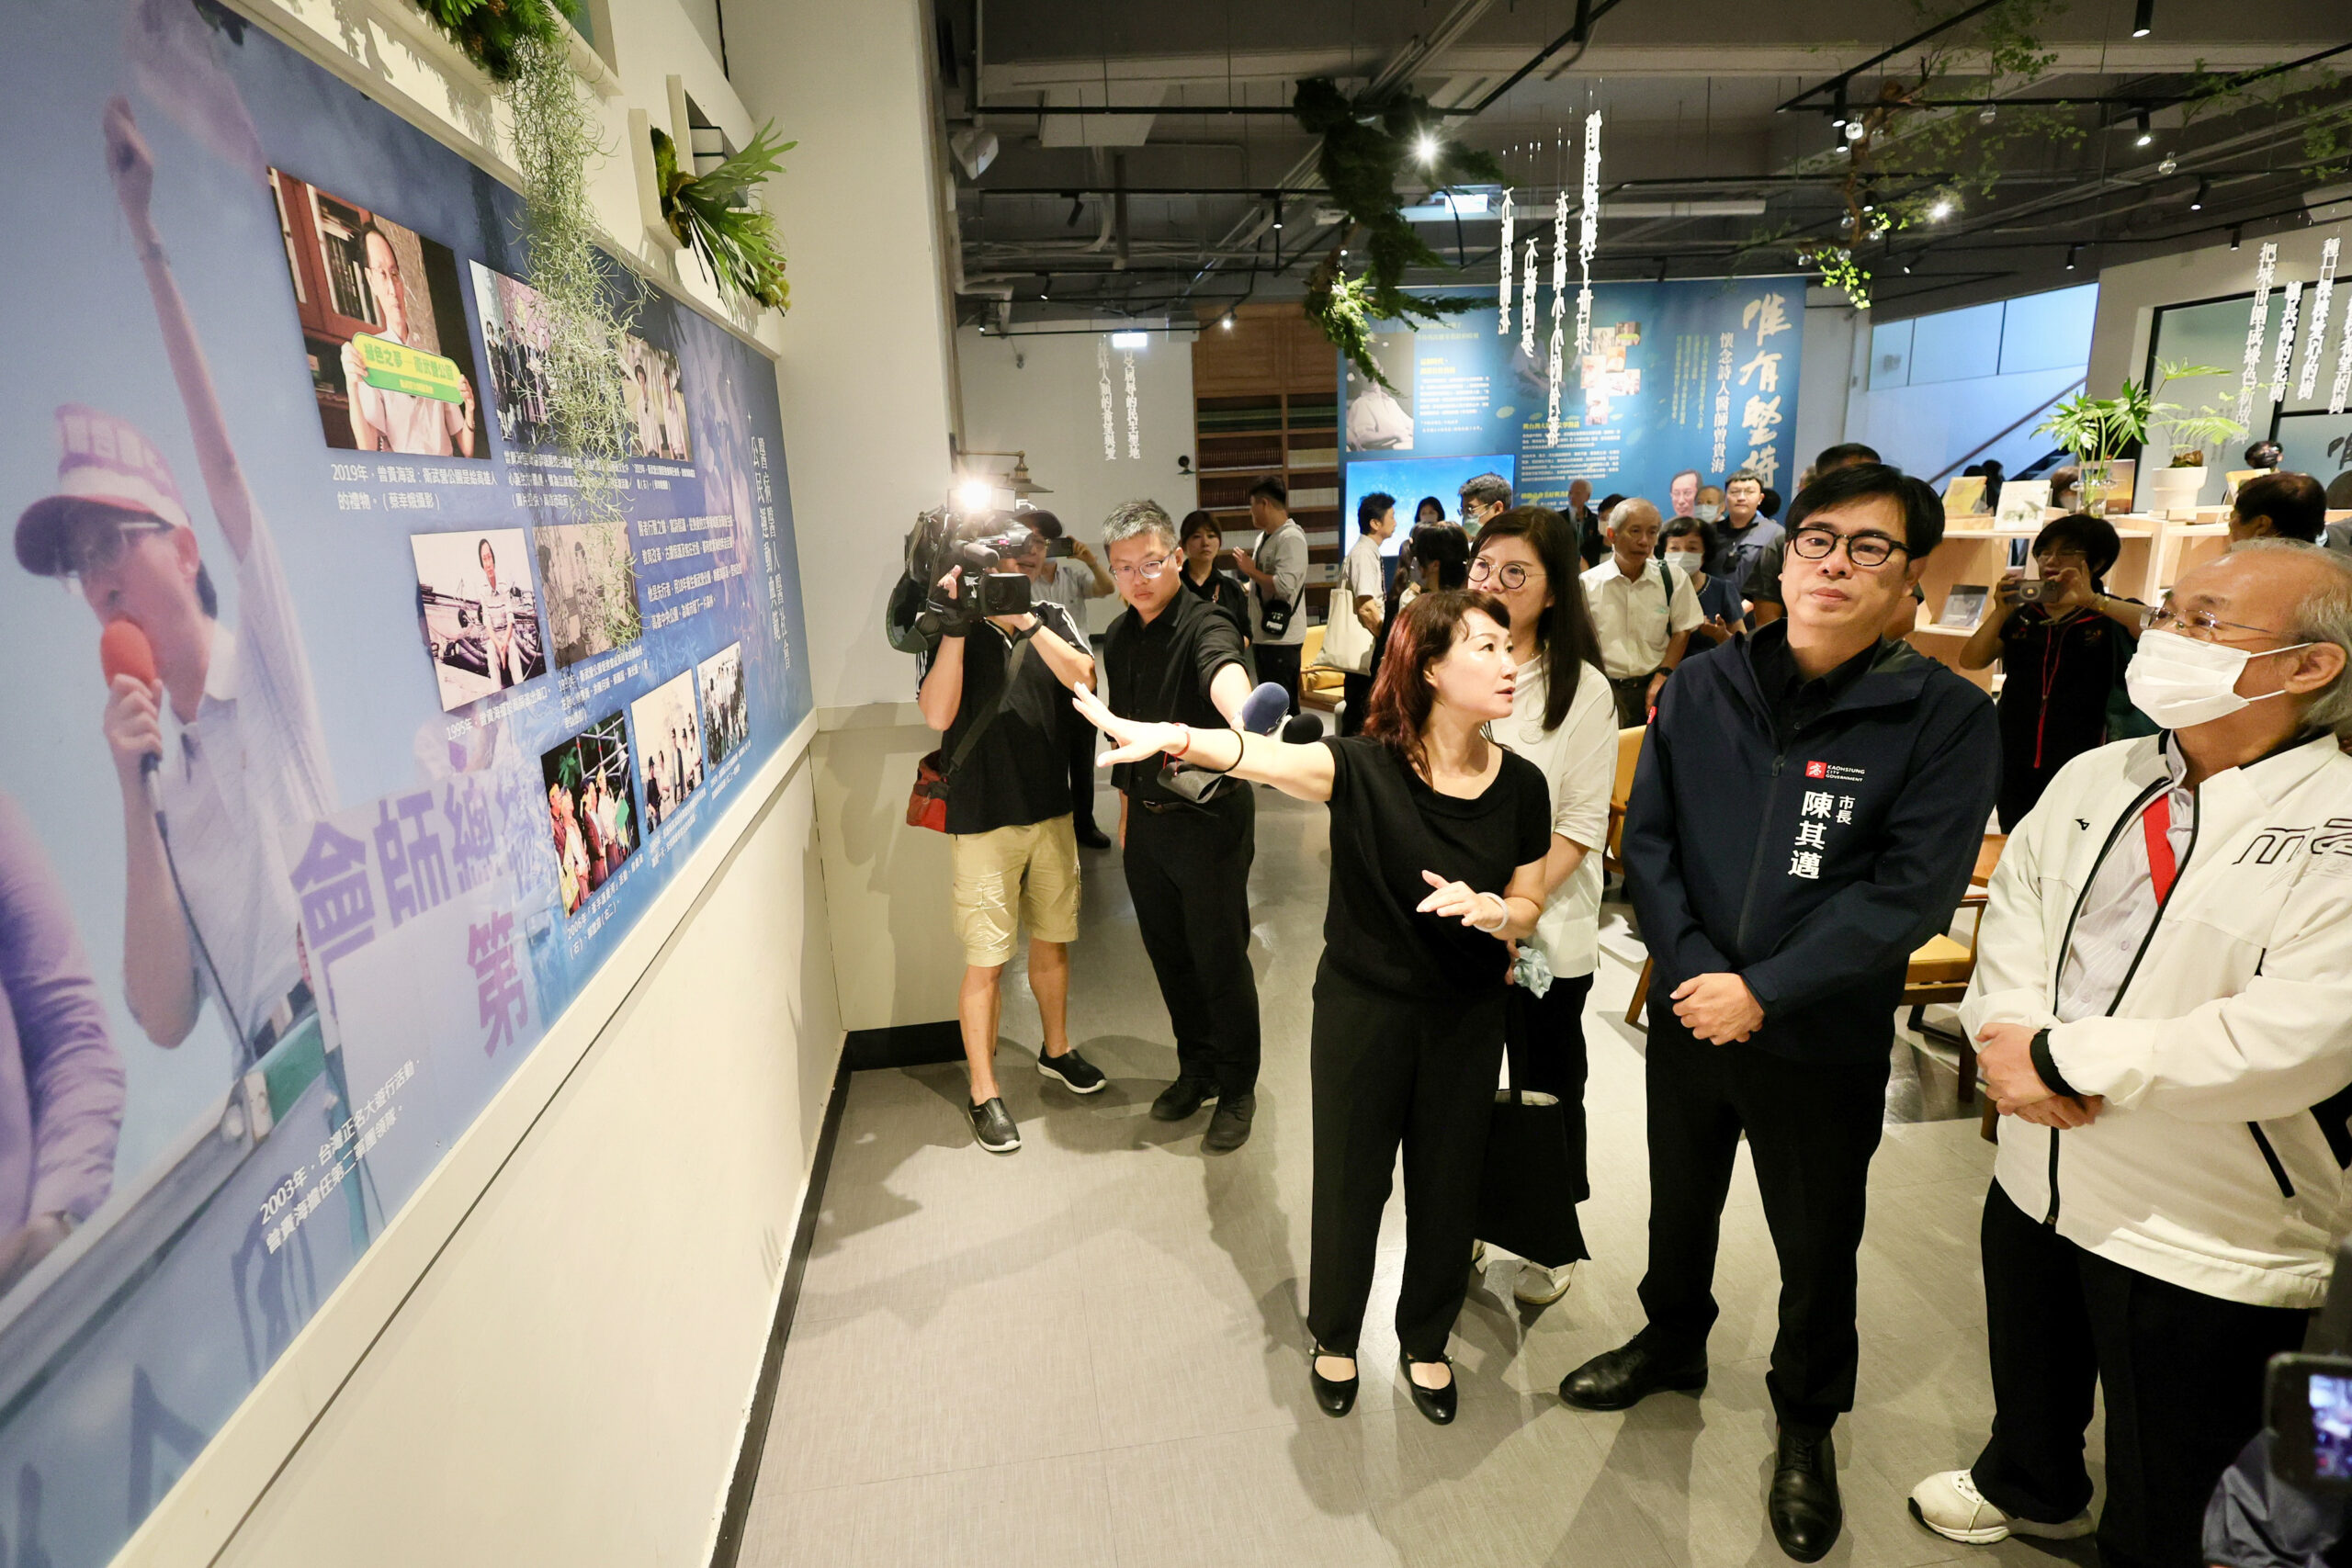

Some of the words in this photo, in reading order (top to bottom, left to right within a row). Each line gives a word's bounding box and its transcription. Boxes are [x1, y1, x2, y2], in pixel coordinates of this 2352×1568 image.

[1711, 332, 1735, 474] 懷念詩人醫師曾貴海
[750, 435, 781, 641] 公民運動典範
[757, 437, 791, 670] 醫病醫人醫社會
[1825, 773, 1864, 783] GOVERNMENT
[1826, 764, 1865, 775] KAOHSIUNG
[1836, 795, 1856, 825] 市長
[1788, 791, 1835, 879] 陳其邁
